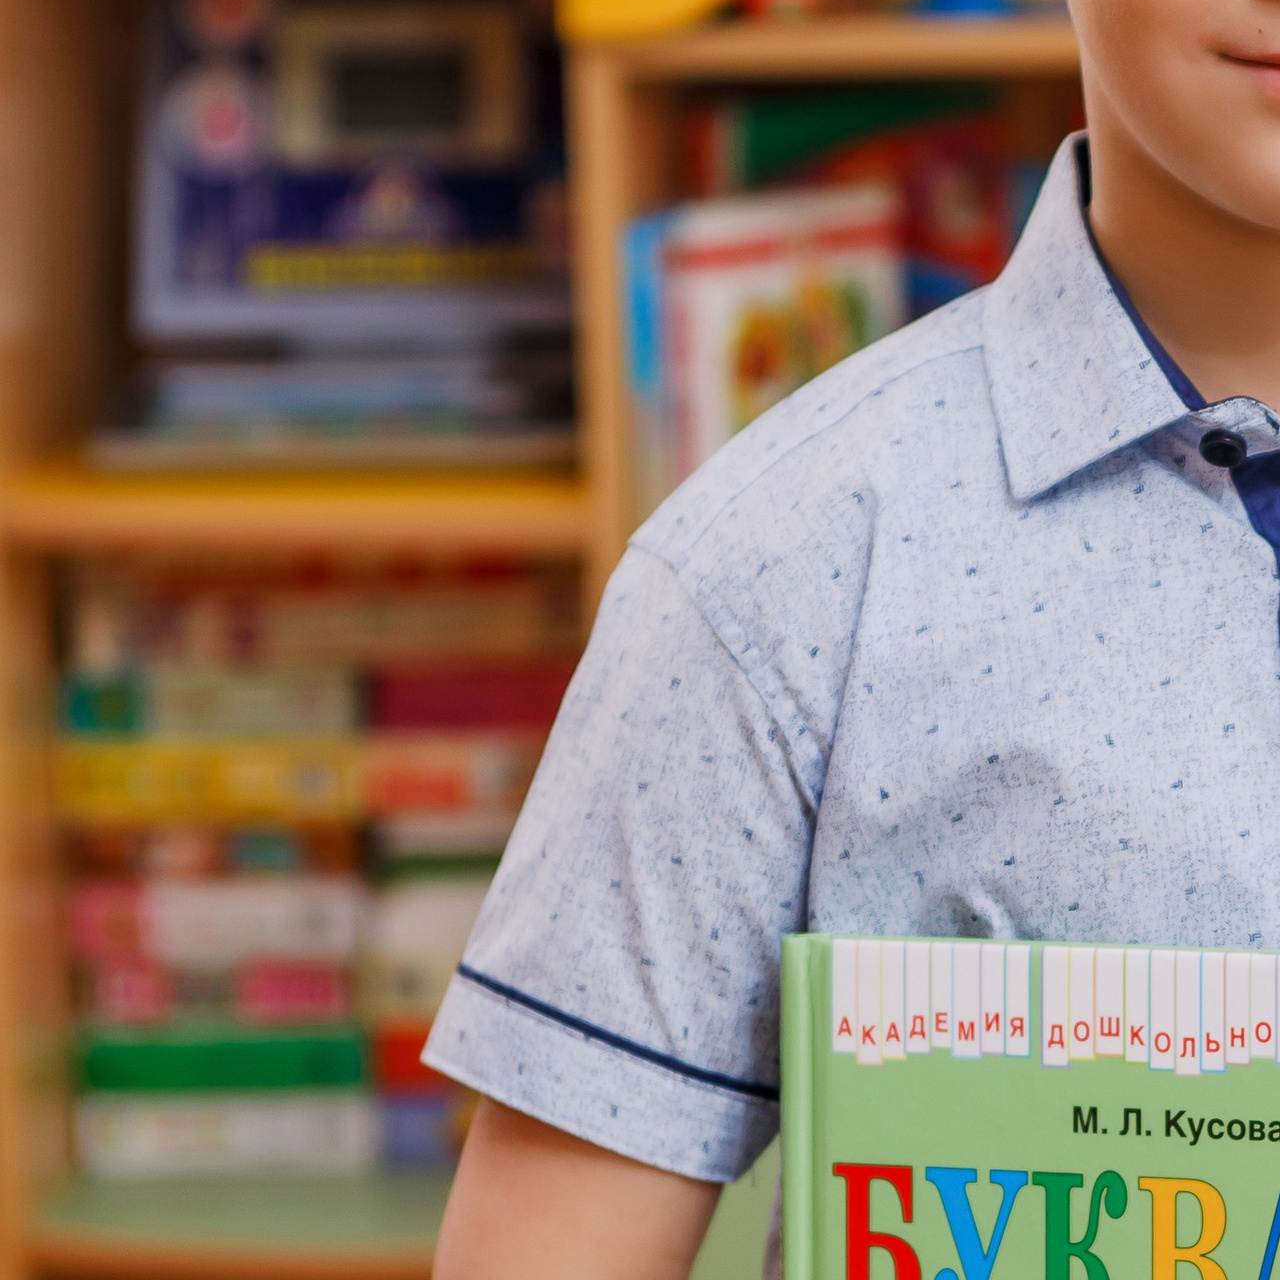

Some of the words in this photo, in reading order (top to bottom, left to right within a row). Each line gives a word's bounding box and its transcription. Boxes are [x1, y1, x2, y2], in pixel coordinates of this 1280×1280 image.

[837, 1011, 1025, 1045] АКАДЕМИЯ
[1073, 1105, 1108, 1135] М.
[1119, 1108, 1152, 1136] Л.
